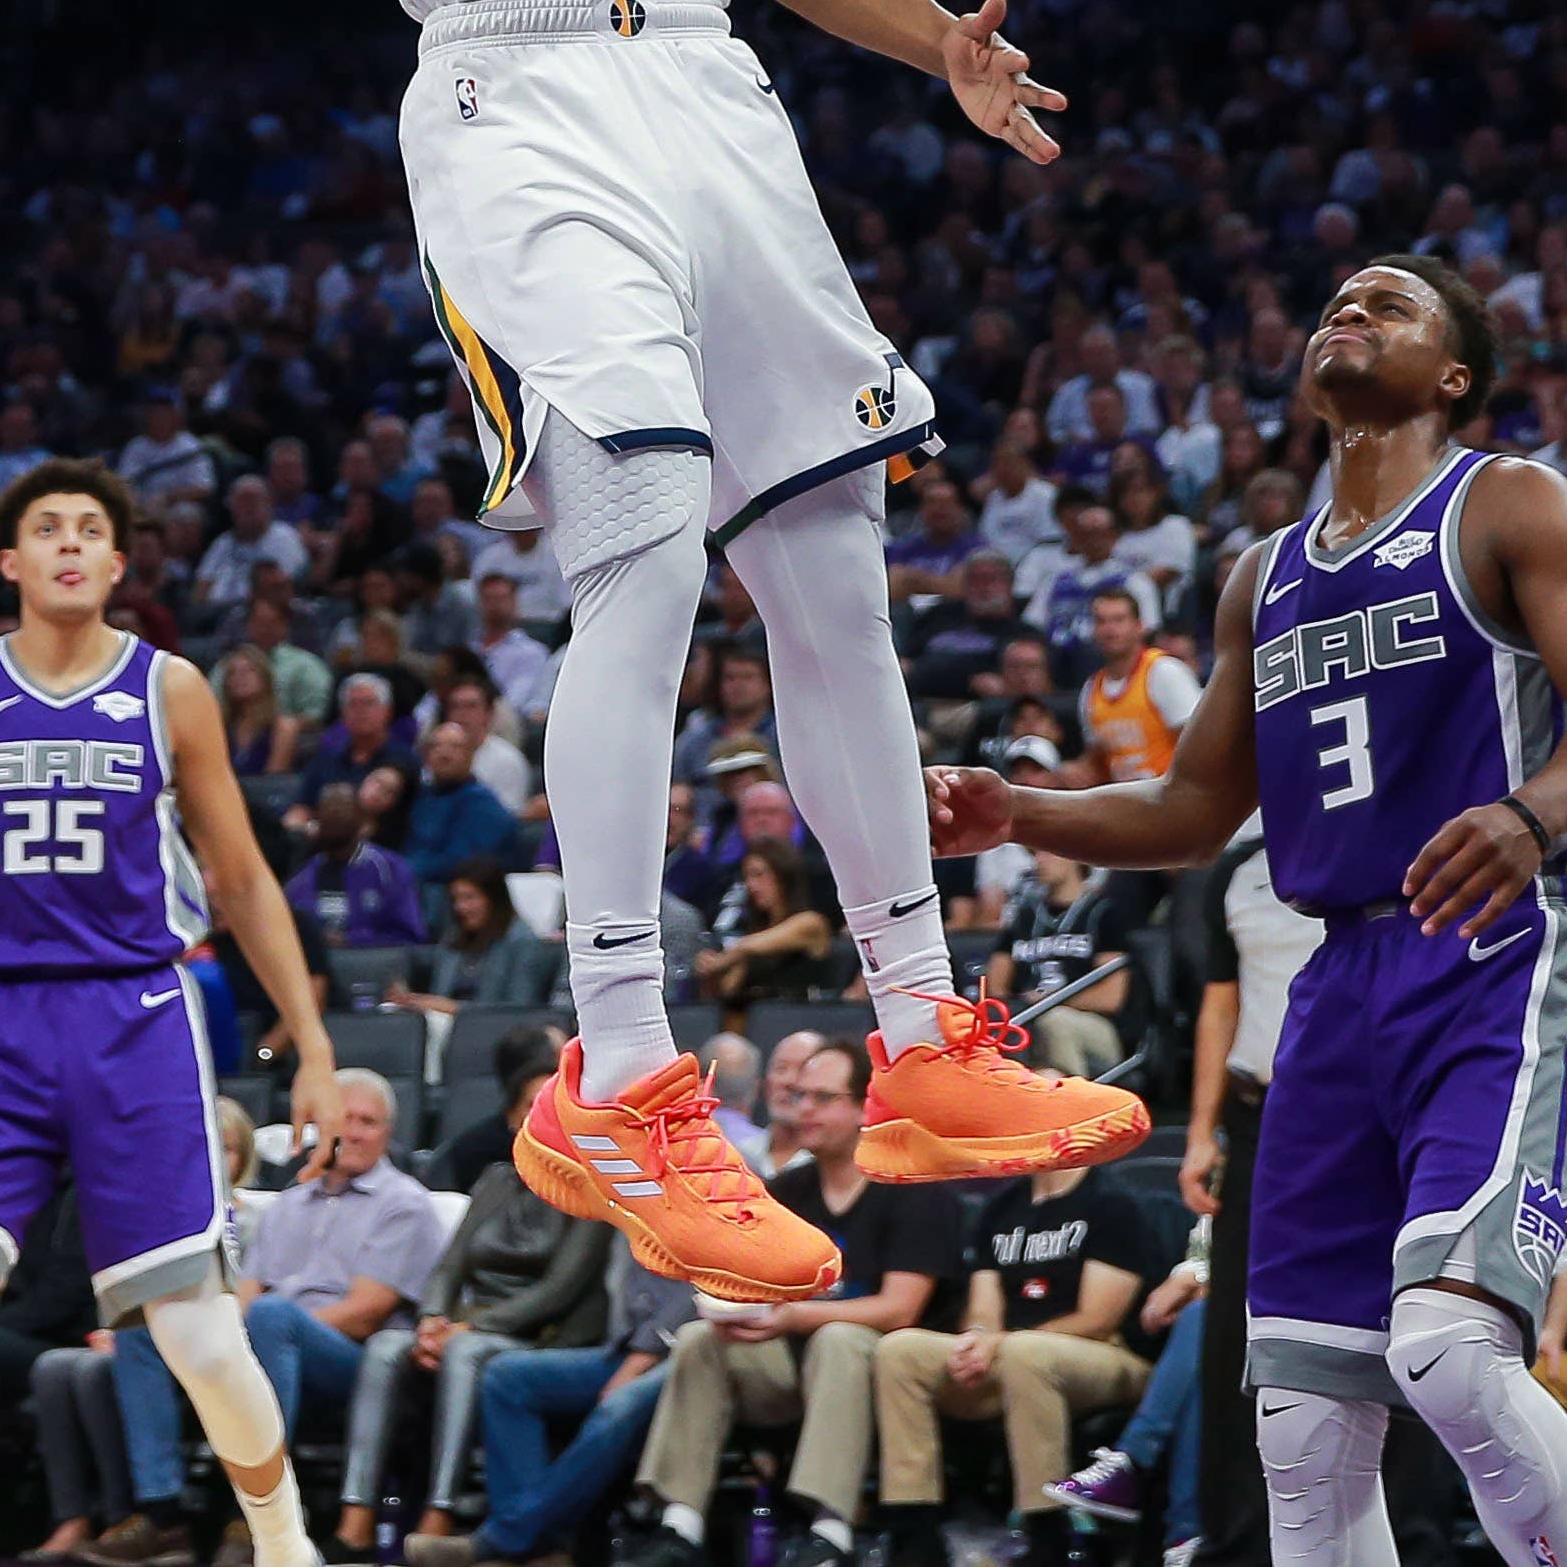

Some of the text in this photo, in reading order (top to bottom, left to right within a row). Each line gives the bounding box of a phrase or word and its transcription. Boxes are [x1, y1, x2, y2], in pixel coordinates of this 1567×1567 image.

[1254, 591, 1446, 713] SAC
[1310, 695, 1376, 811] 3
[2, 799, 105, 875] 25
[1518, 1206, 1566, 1253] SA
